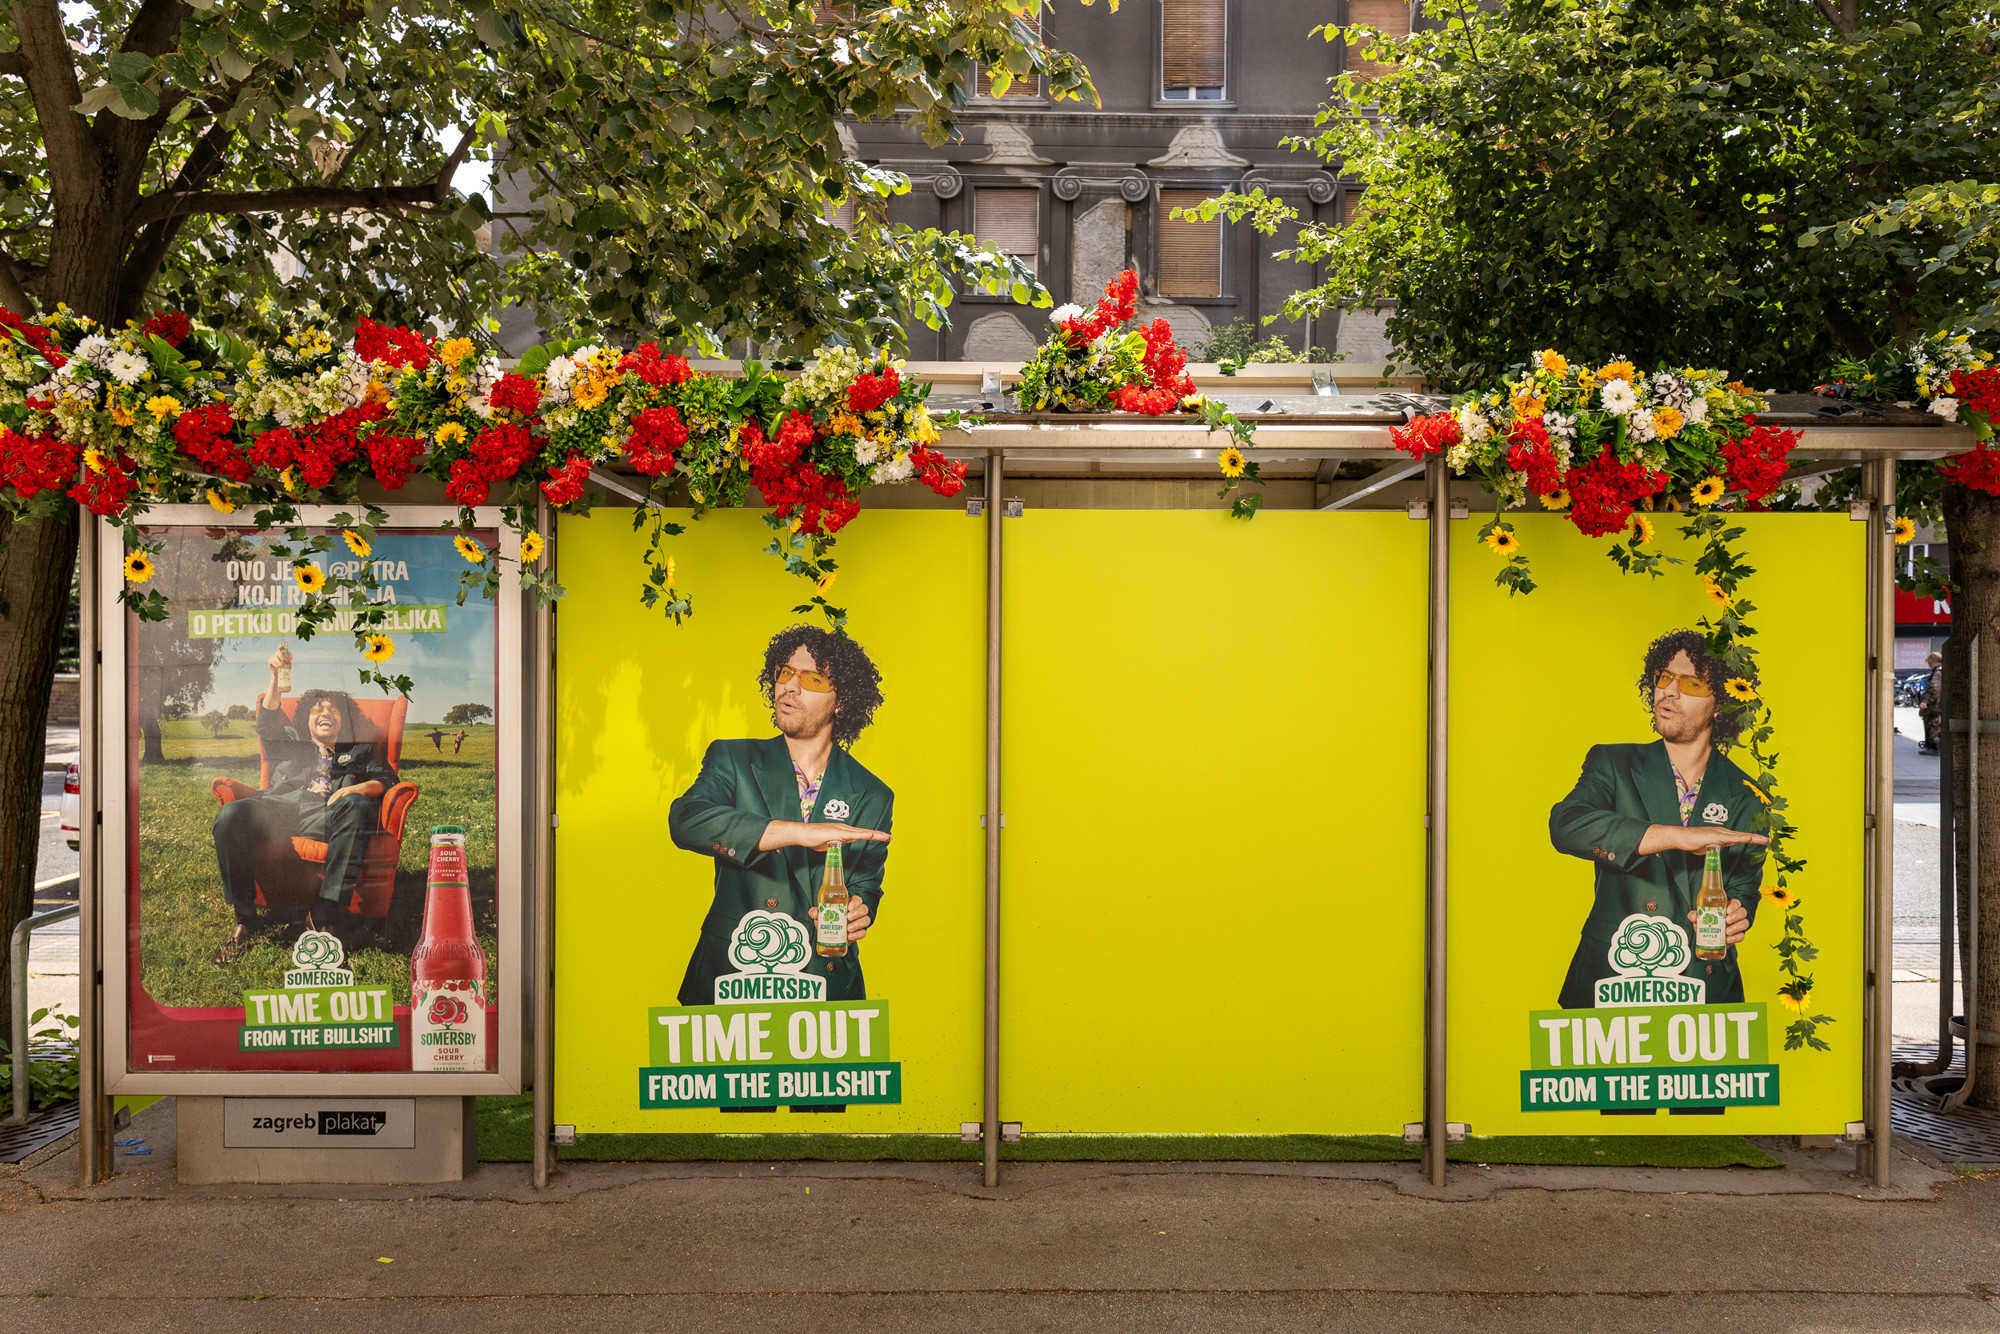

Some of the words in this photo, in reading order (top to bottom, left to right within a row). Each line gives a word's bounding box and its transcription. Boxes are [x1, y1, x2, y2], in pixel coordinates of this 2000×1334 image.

[226, 561, 265, 581] OVO
[271, 561, 294, 581] JE
[238, 585, 282, 605] KOJI
[193, 615, 206, 635] O
[211, 613, 272, 634] PETKU
[287, 972, 351, 986] SOMERSBY
[718, 976, 823, 1000] SOMERSBY
[1598, 980, 1702, 1003] SOMERSBY
[249, 992, 322, 1024] TIME
[329, 990, 387, 1022] OUT
[244, 1029, 287, 1047] FROM
[290, 1028, 320, 1046] THE
[323, 1026, 393, 1045] BULLSHIT
[420, 1031, 477, 1046] SOMERSBY
[657, 1012, 773, 1063] TIME
[788, 1008, 879, 1060] OUT
[1538, 1015, 1653, 1066] TIME
[1667, 1011, 1759, 1063] OUT
[648, 1073, 716, 1101] FROM
[724, 1072, 770, 1098] THE
[778, 1070, 891, 1098] BULLSHIT
[1529, 1076, 1597, 1103] FROM
[1604, 1075, 1650, 1101] THE
[1657, 1072, 1770, 1100] BULLSHIT
[252, 1112, 316, 1133] zagreb
[325, 1111, 377, 1132] plakat
